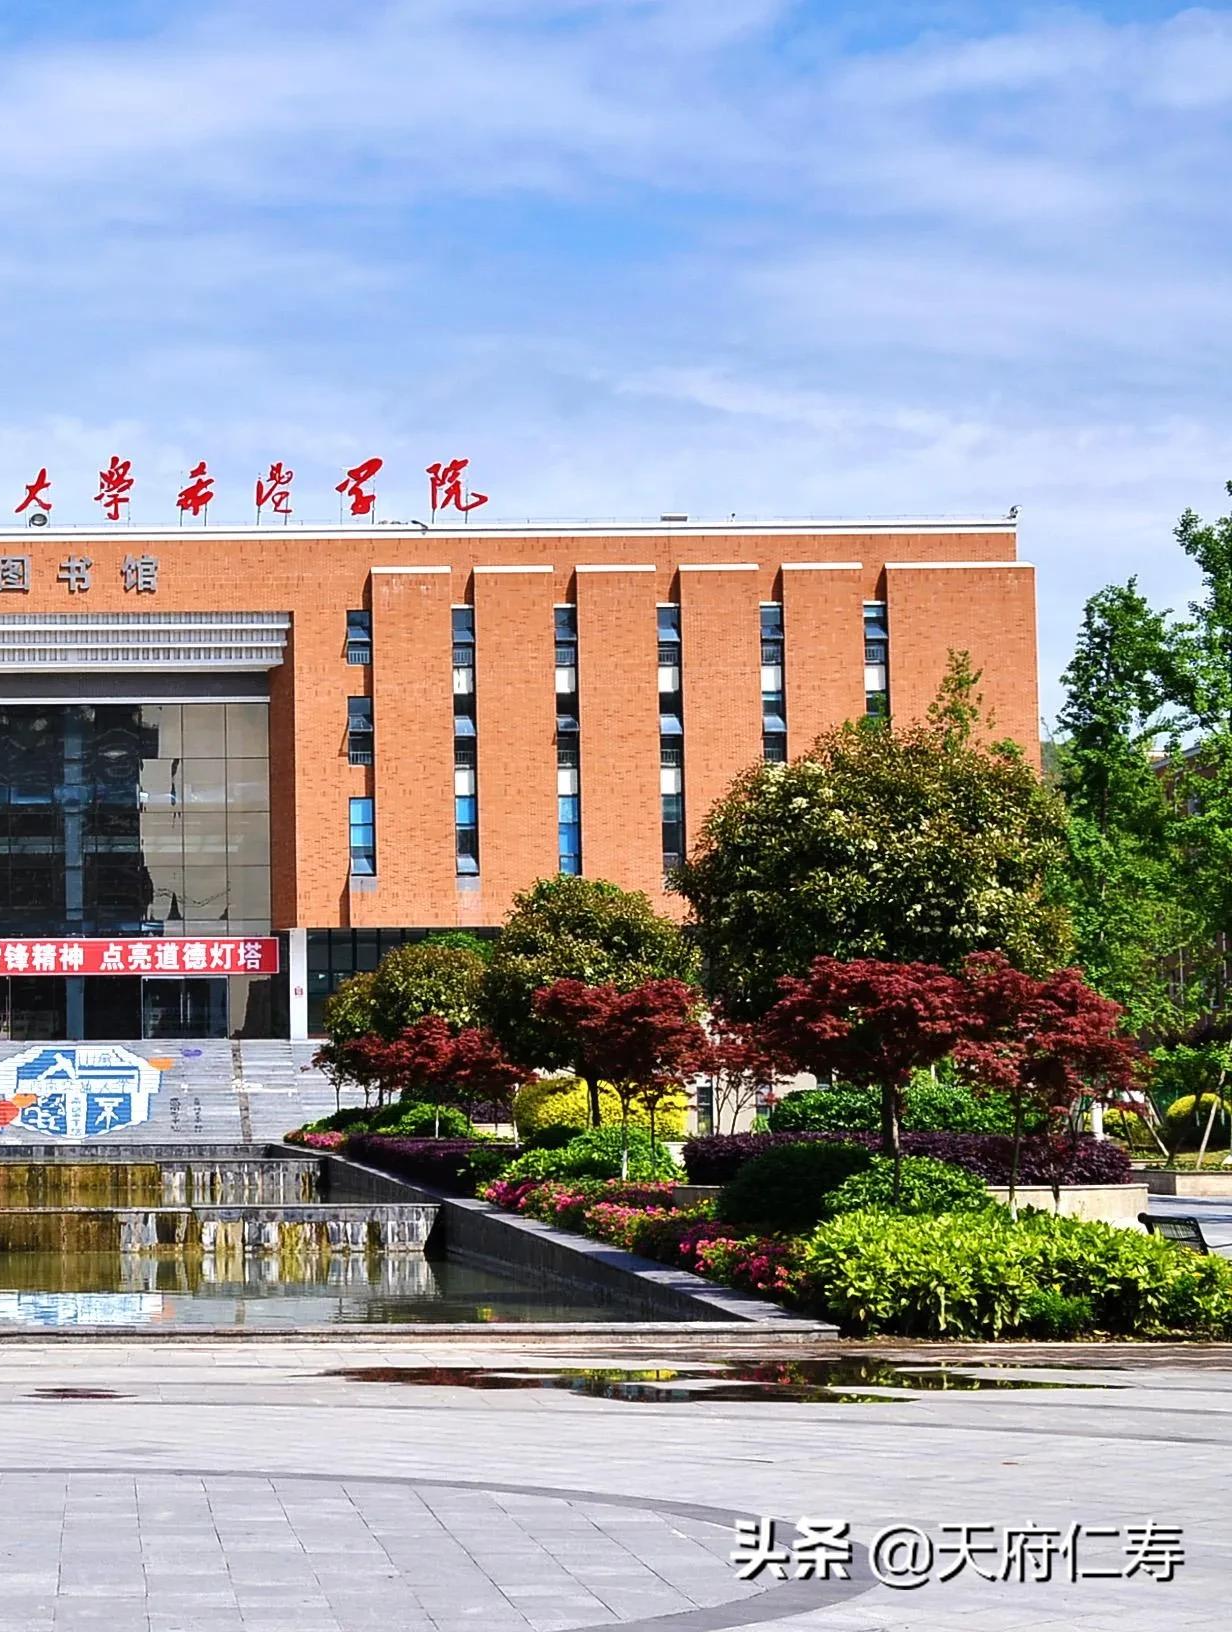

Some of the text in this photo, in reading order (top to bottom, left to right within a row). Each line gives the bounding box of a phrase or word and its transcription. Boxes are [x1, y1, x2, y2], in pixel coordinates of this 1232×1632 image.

[99, 943, 262, 972] 点亮道德灯塔
